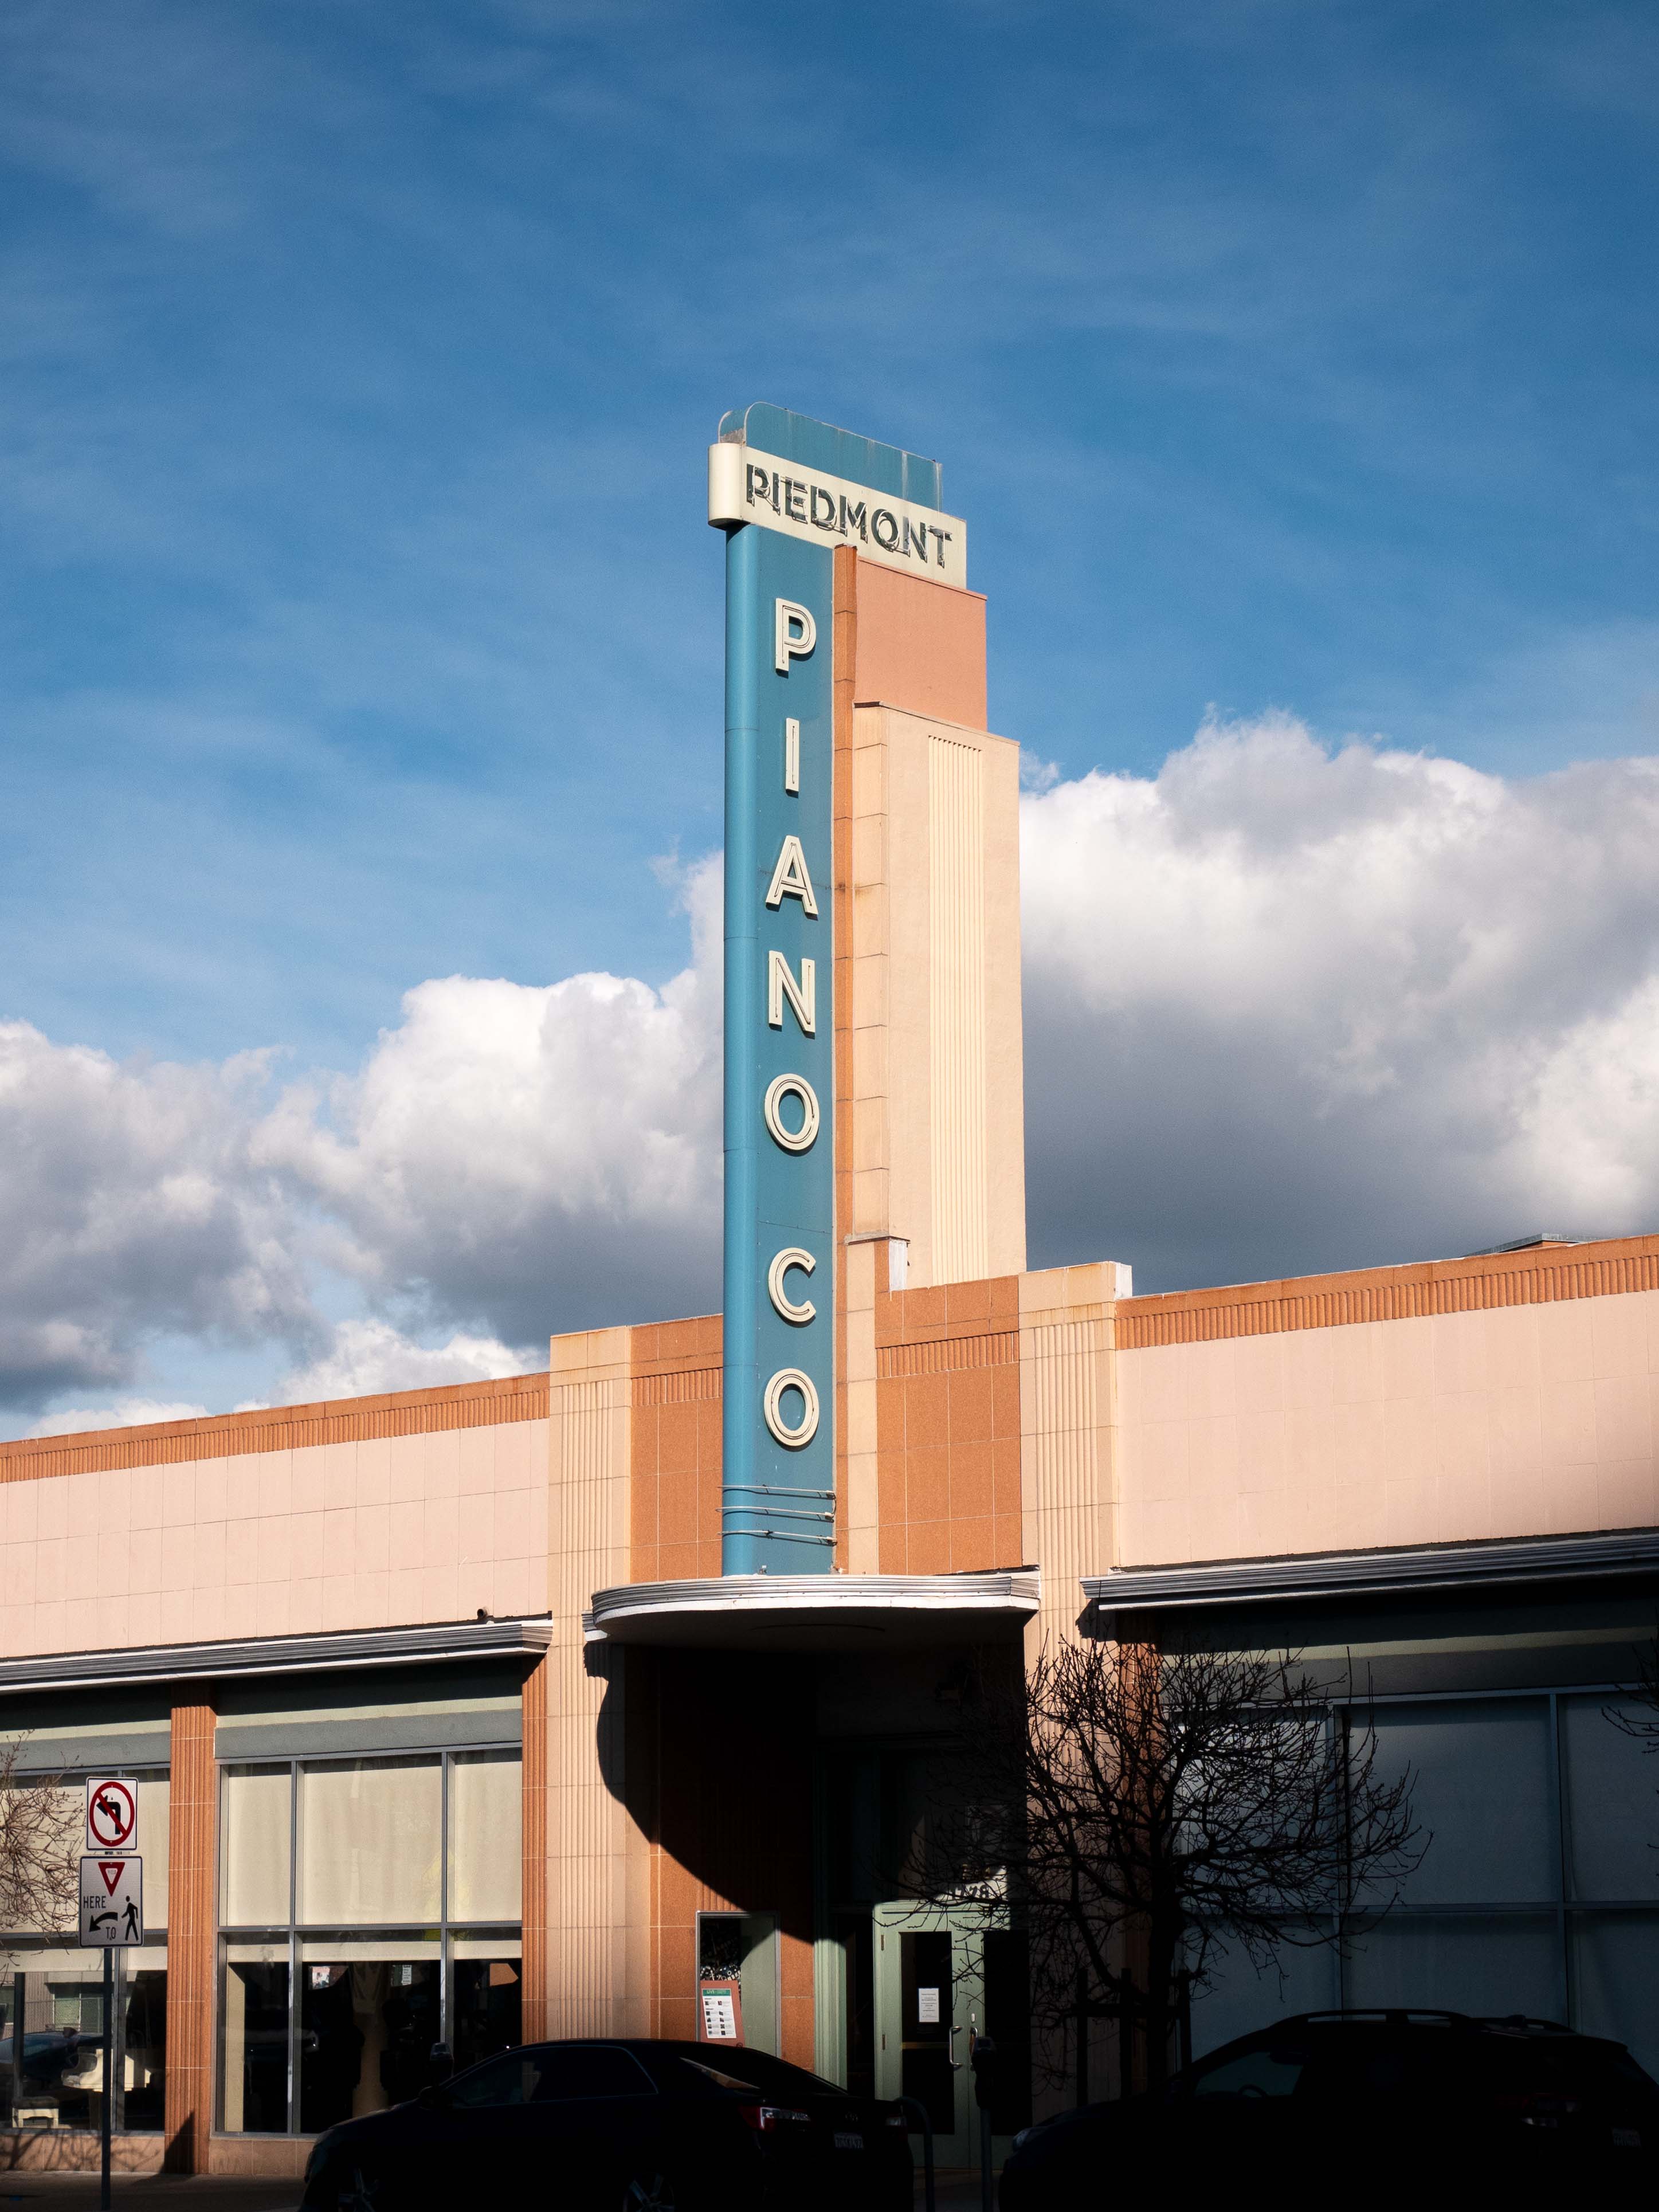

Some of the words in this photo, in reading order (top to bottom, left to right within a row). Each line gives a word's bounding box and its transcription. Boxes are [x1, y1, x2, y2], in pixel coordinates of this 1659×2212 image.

[746, 463, 952, 568] PIEDMONT
[764, 597, 819, 1151] PIANO
[764, 1246, 819, 1446] CO
[83, 1896, 106, 1908] HERE
[105, 1927, 116, 1939] TO
